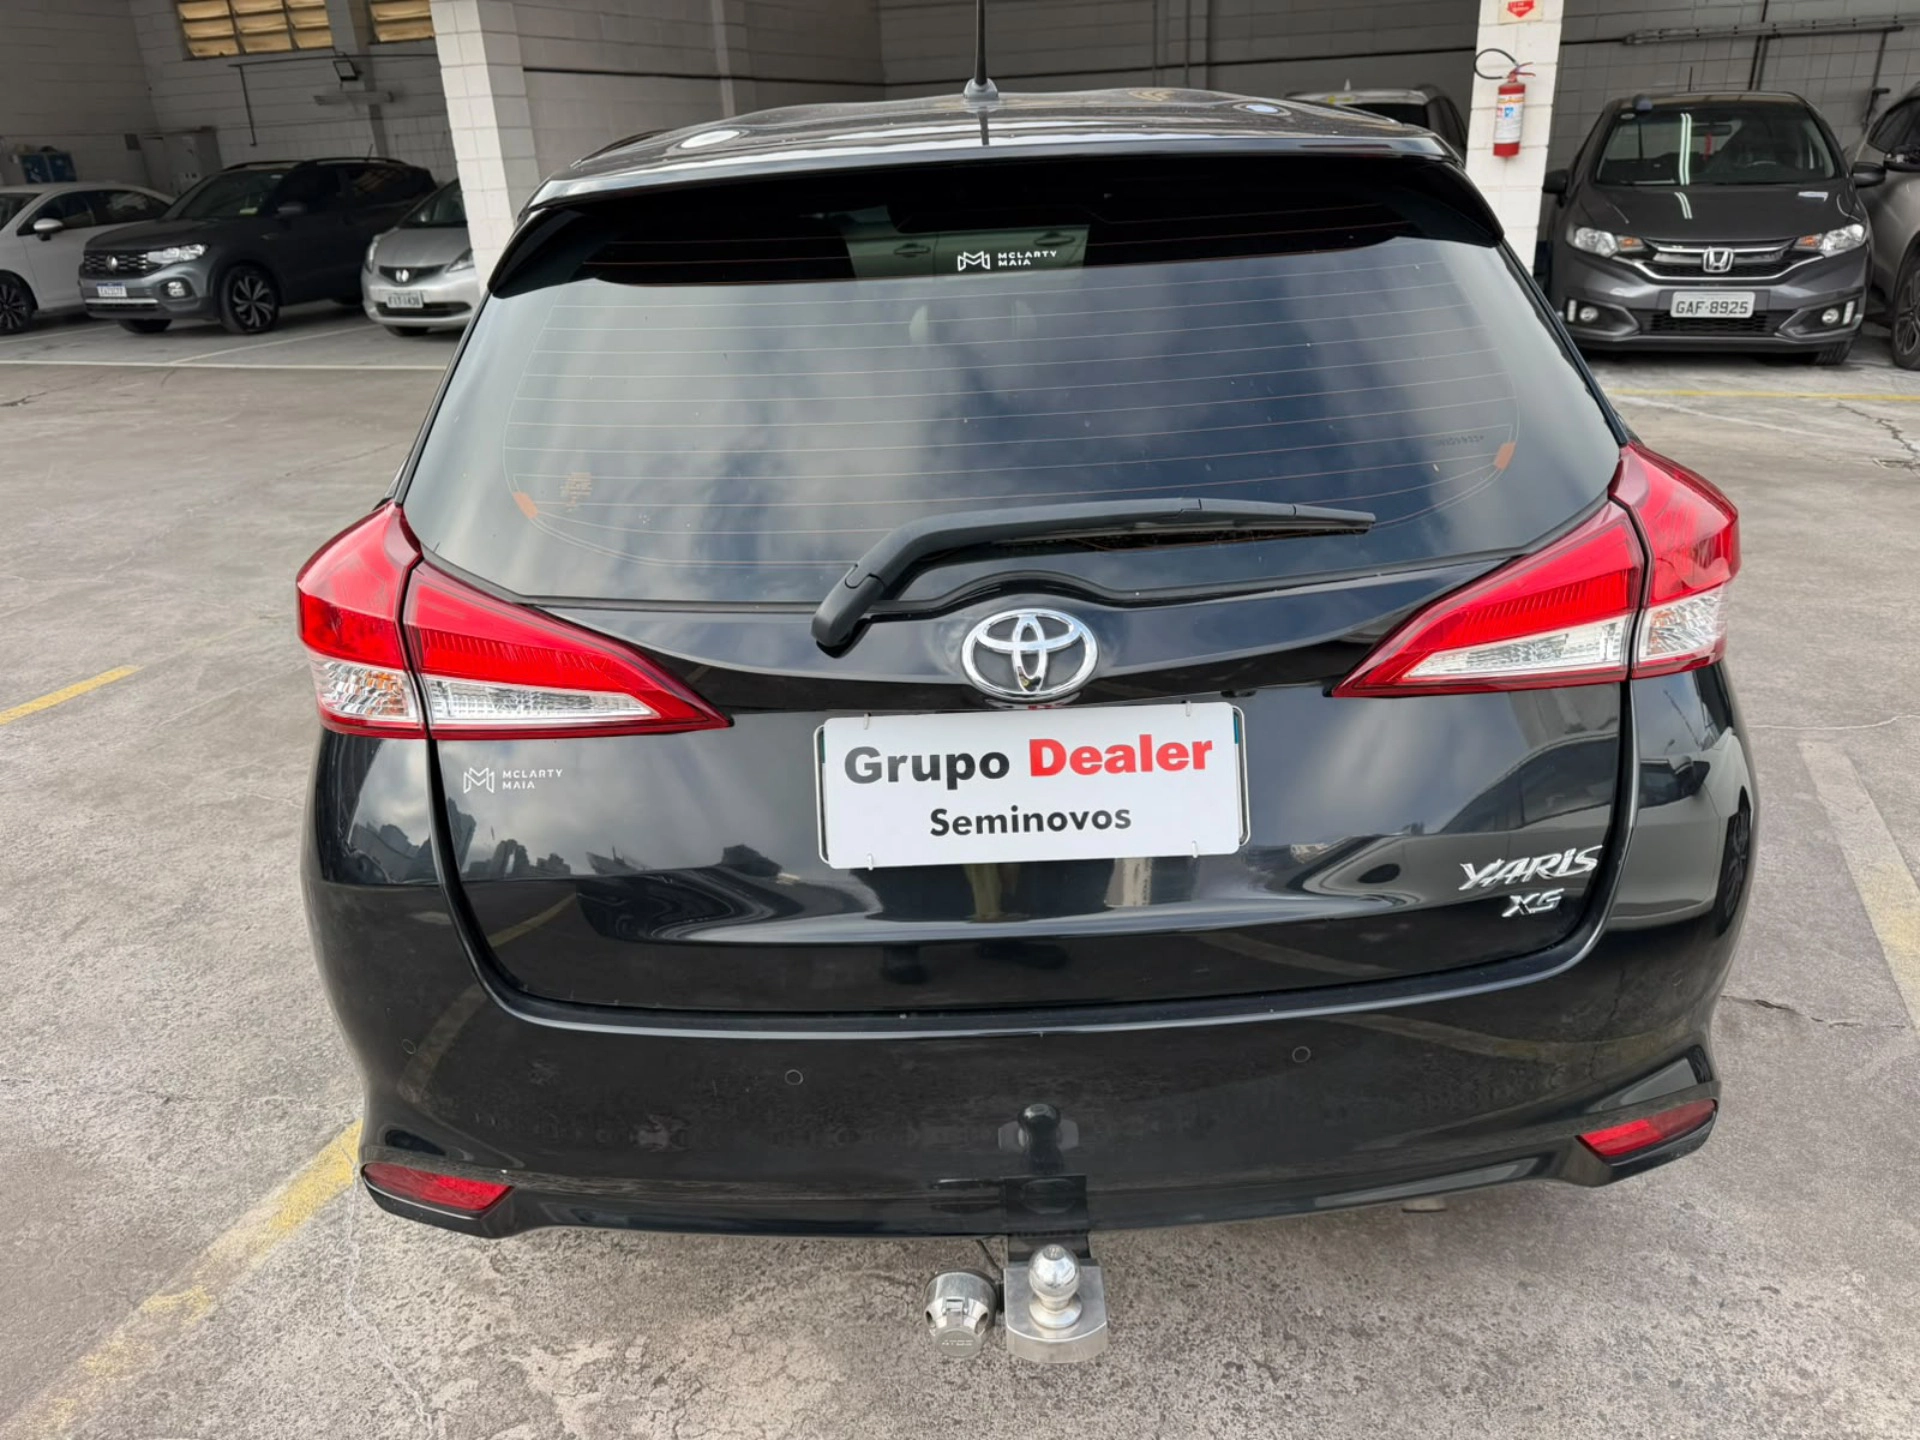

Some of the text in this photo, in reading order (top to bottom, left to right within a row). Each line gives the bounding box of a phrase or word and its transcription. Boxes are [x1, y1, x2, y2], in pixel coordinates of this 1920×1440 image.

[997, 250, 1057, 259] MCLARTY
[997, 259, 1031, 267] MAIA
[844, 734, 1213, 790] Grupo Dealer
[502, 769, 563, 779] MCLARTY
[502, 780, 536, 790] MAIA
[930, 805, 1132, 837] Seminovos
[1458, 844, 1603, 891] YARIS
